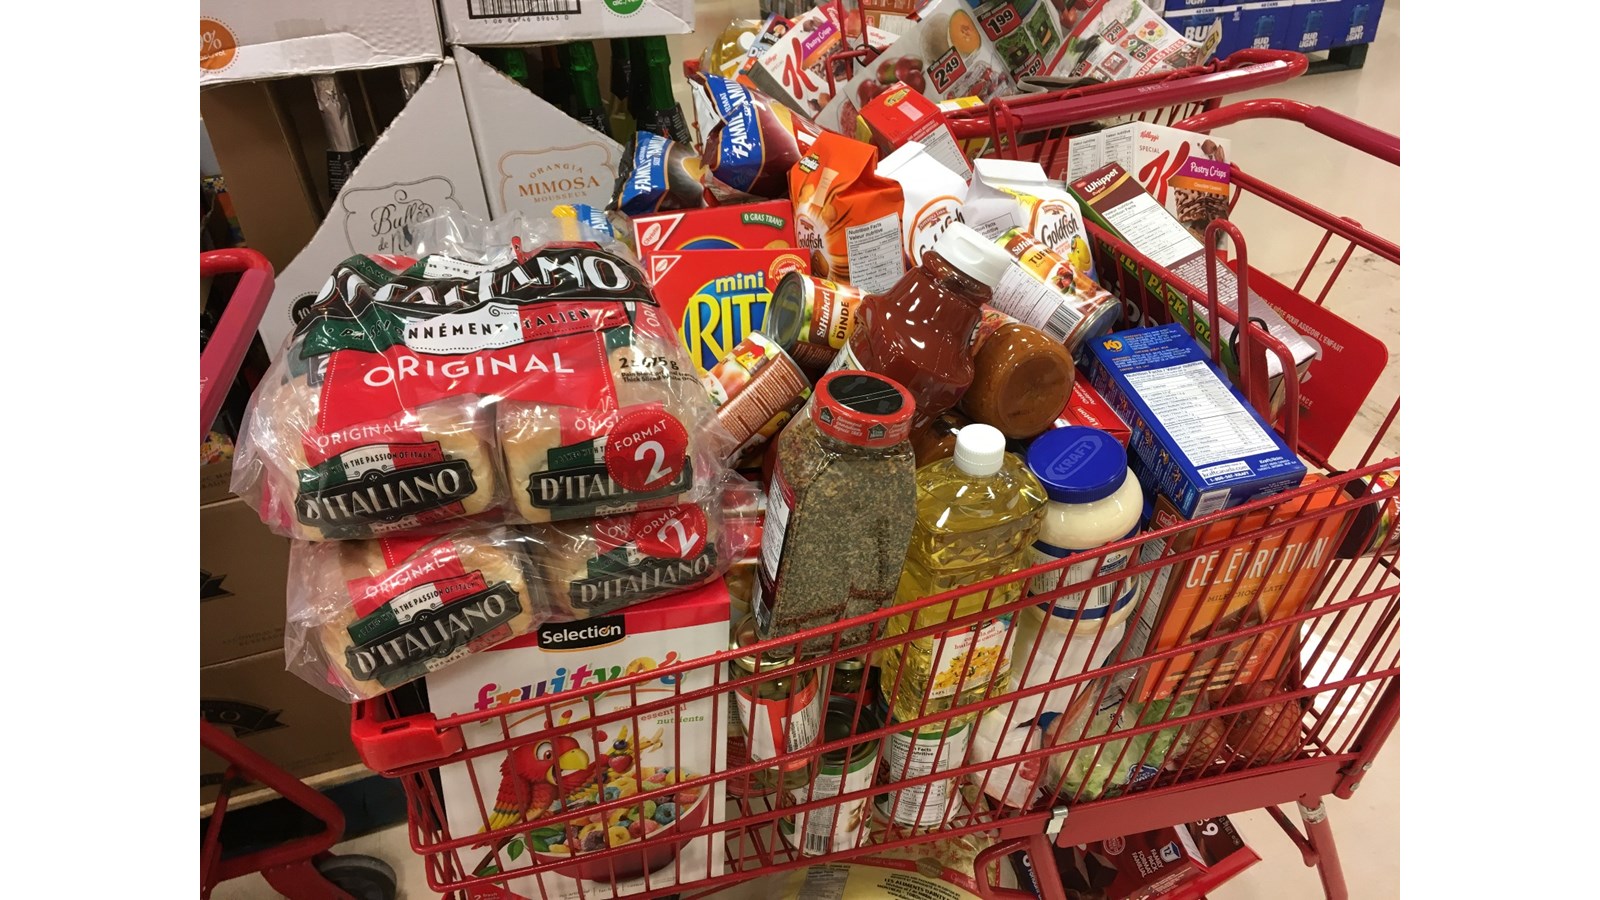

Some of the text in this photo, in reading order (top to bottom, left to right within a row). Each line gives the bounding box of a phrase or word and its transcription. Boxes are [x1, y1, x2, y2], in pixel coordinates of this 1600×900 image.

[1303, 32, 1319, 40] BUD
[1350, 25, 1364, 34] BUD
[1253, 37, 1270, 45] BUD
[1154, 50, 1167, 62] LES
[1139, 145, 1160, 154] SPECIAL
[529, 163, 583, 178] ORANGIA
[1085, 168, 1119, 193] Whippet
[1190, 162, 1227, 180] Pastry Crisps
[518, 176, 600, 197] MIMOSA
[744, 213, 783, 226] 0 GRAS TRANS
[1041, 213, 1080, 250] Goldfish
[715, 271, 764, 293] mini
[513, 309, 591, 330] ITALIEN
[816, 290, 831, 338] StHubert
[836, 301, 850, 340] DINDE
[1286, 313, 1300, 326] POUR
[1298, 319, 1320, 339] ASSEOIR
[1319, 335, 1344, 353] L'ENFANT
[363, 352, 574, 387] ORIGINAL
[619, 357, 628, 369] 2
[1077, 406, 1101, 427] Lipton
[317, 420, 405, 448] ORIGINAL
[614, 420, 668, 451] FORMAT
[349, 457, 364, 468] THE
[365, 452, 397, 464] PASSION
[634, 441, 673, 485] 2
[1054, 442, 1092, 474] KRAFT
[303, 468, 460, 520] D'ITALIANO
[637, 505, 683, 539] FORMAT
[657, 518, 699, 557] 2
[365, 557, 445, 599] ORIGINAL
[581, 554, 710, 602] D'ITALIANO
[399, 602, 413, 614] THE
[414, 591, 443, 608] PASSION
[445, 586, 454, 595] OF
[1233, 584, 1286, 599] CHOCLATE
[355, 594, 506, 673] D'ITALIANO
[542, 624, 622, 644] Selection
[1137, 850, 1153, 875] FORMAT
[1151, 848, 1163, 869] FAMILY
[1163, 846, 1172, 857] 12
[1132, 852, 1147, 879] FAMILIAL
[1147, 855, 1158, 872] PACK
[895, 880, 925, 891] ALIMENTS
